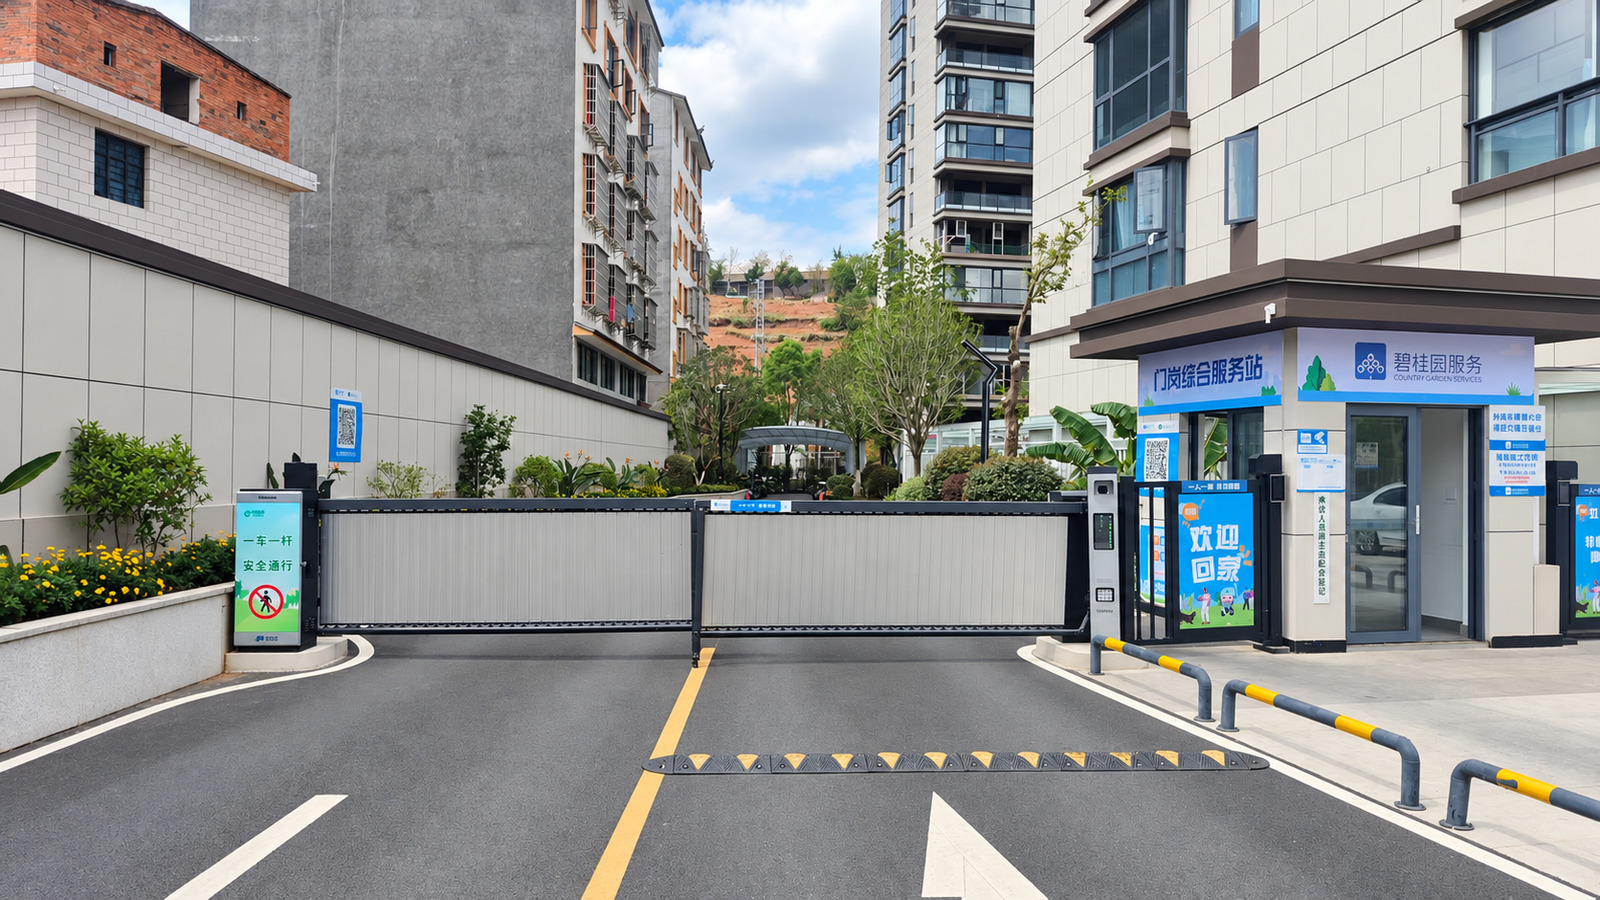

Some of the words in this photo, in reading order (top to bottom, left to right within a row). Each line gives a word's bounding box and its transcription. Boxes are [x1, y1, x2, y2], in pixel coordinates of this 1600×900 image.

[1154, 353, 1263, 392] 门岗综合服务站
[1394, 352, 1482, 375] 碧桂园服务
[243, 535, 293, 547] 一车一杆
[1189, 524, 1239, 552] 欢迎
[243, 559, 293, 572] 安全通行
[1191, 555, 1241, 584] 回家
